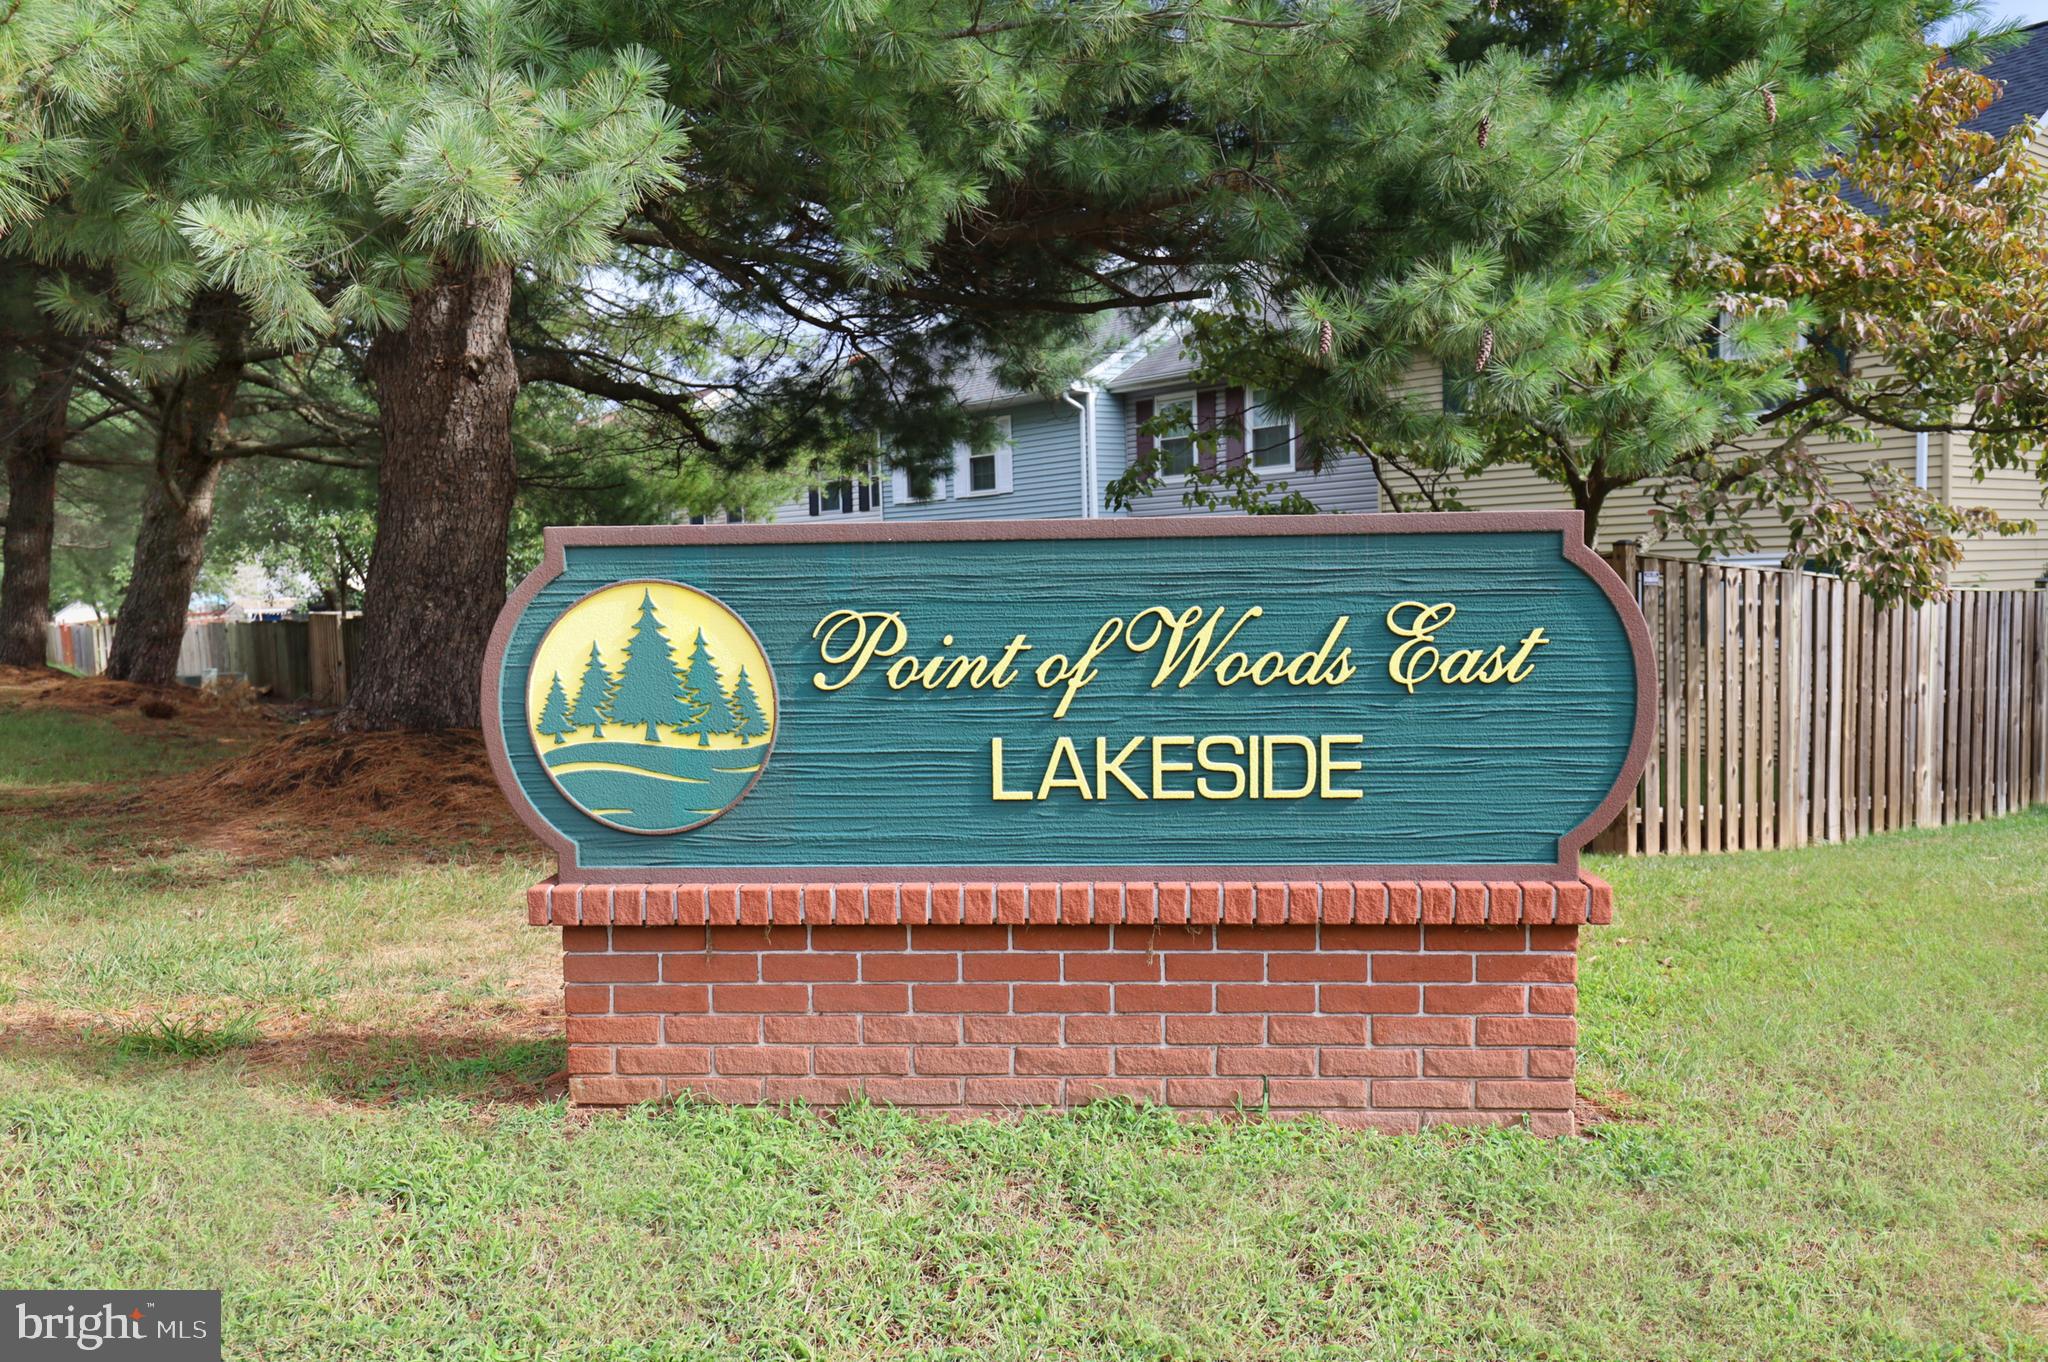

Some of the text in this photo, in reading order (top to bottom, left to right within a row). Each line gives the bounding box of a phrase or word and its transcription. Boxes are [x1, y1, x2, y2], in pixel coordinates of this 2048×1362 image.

[812, 600, 1550, 719] Point of Woods East
[991, 735, 1364, 800] LAKESIDE
